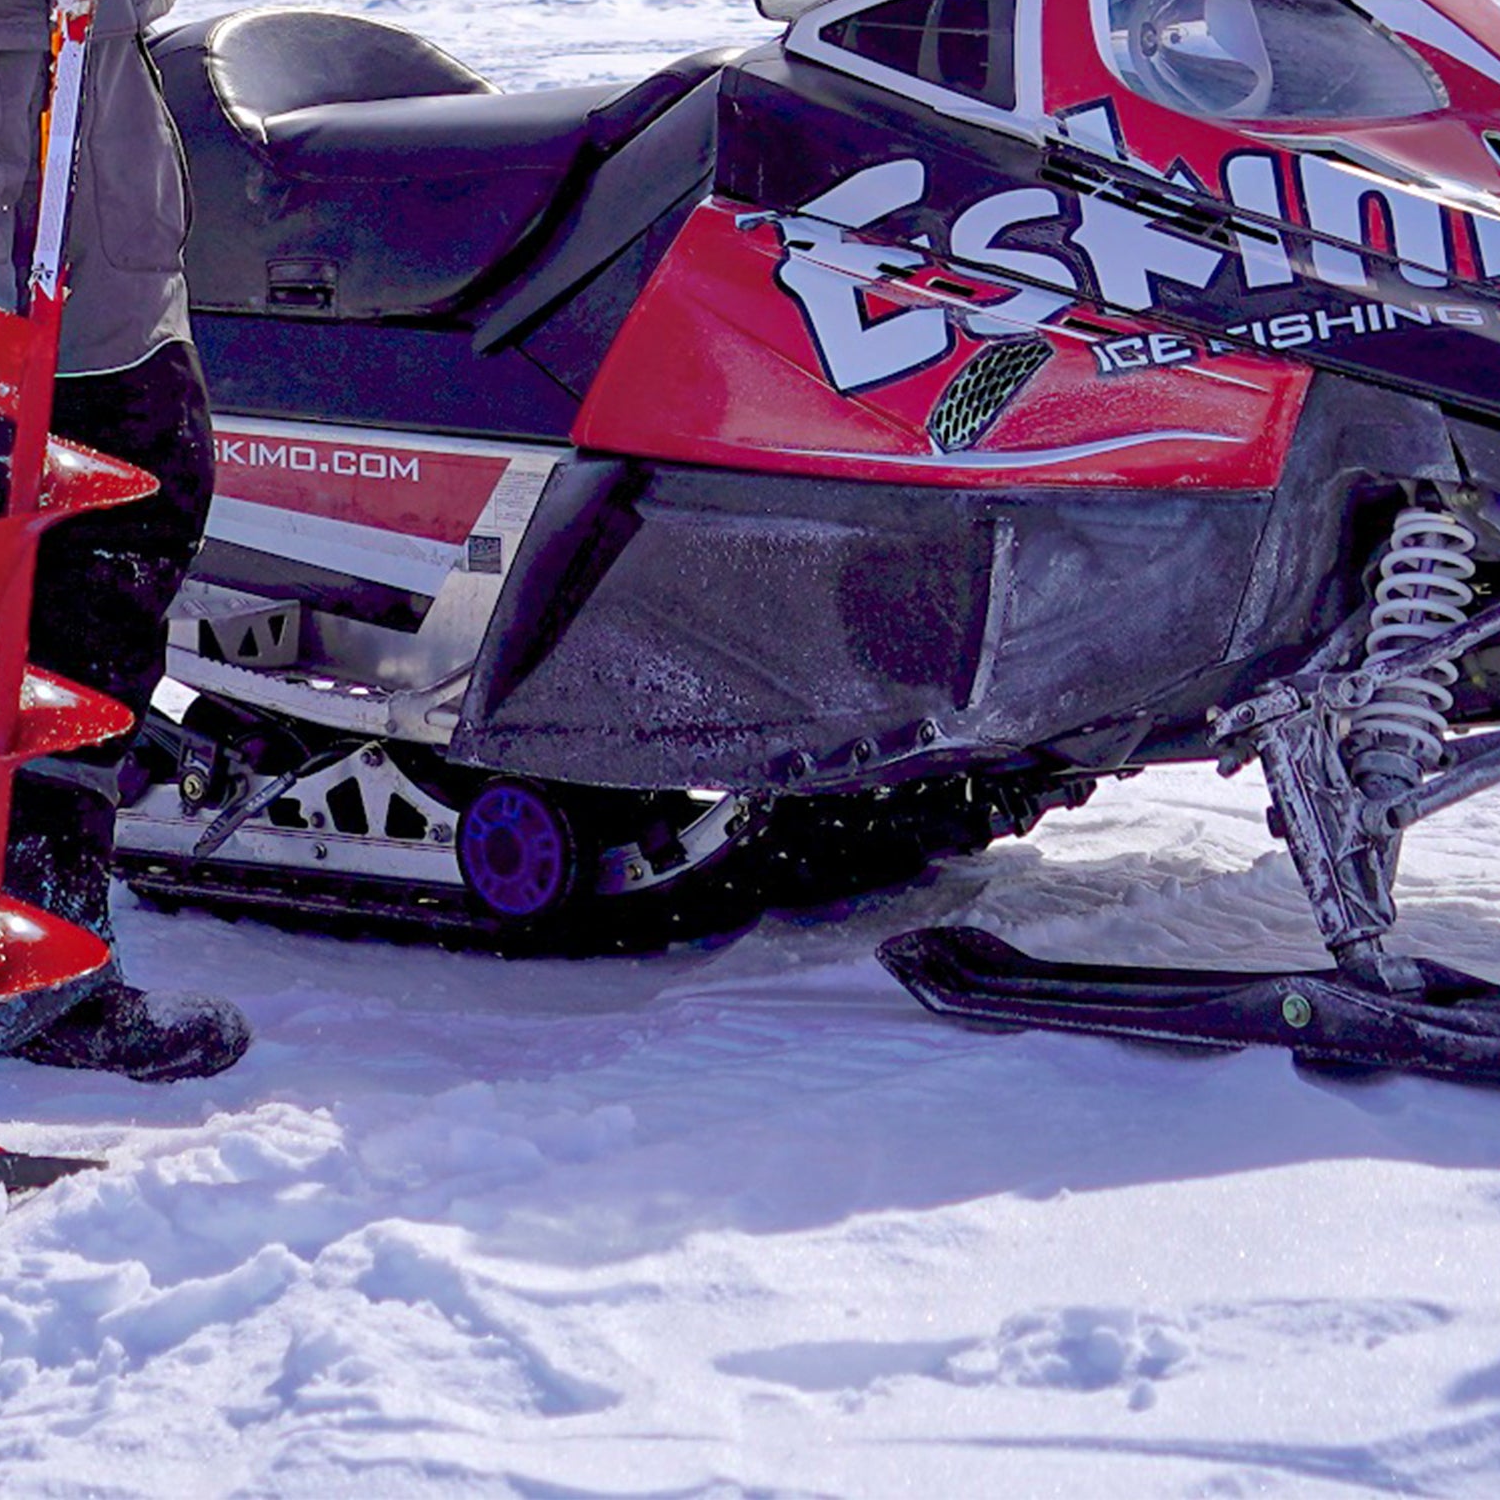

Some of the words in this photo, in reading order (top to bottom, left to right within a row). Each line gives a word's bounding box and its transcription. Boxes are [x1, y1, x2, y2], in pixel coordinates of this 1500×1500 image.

[778, 100, 1500, 393] Eskim
[1092, 333, 1192, 372] ICE
[213, 438, 420, 482] KIMO.COM
